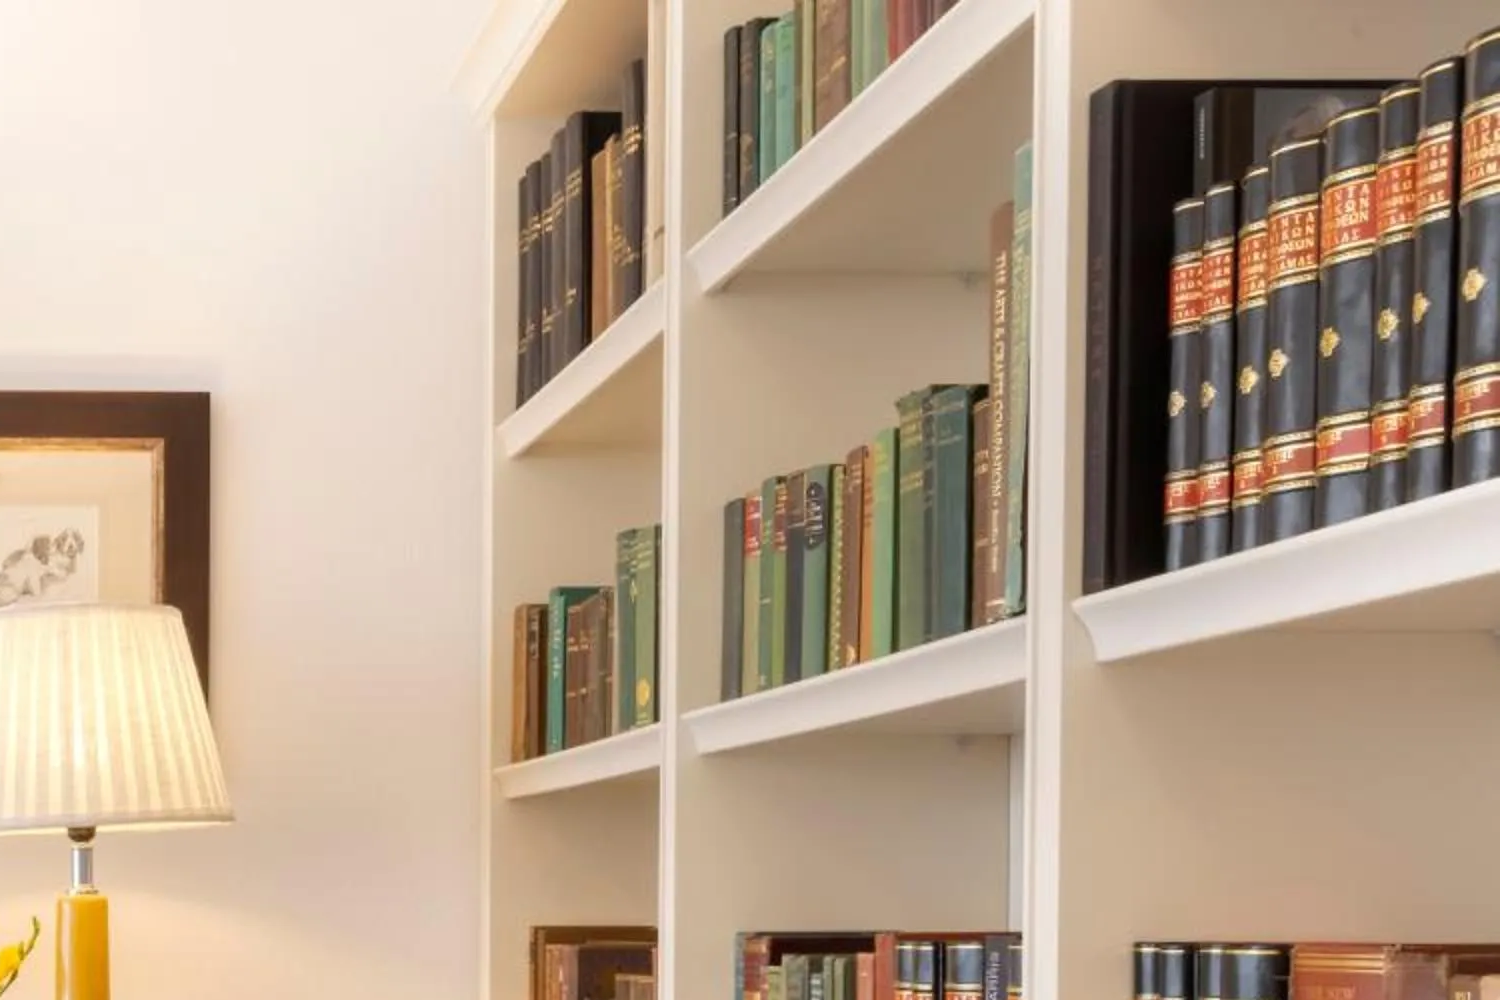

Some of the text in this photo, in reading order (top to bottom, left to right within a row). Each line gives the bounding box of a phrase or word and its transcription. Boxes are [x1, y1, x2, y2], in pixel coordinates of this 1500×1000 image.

[995, 252, 1006, 284] THE
[995, 289, 1005, 324] ARTS
[994, 341, 1005, 395] CRAFTS
[991, 399, 1003, 497] COMPANION
